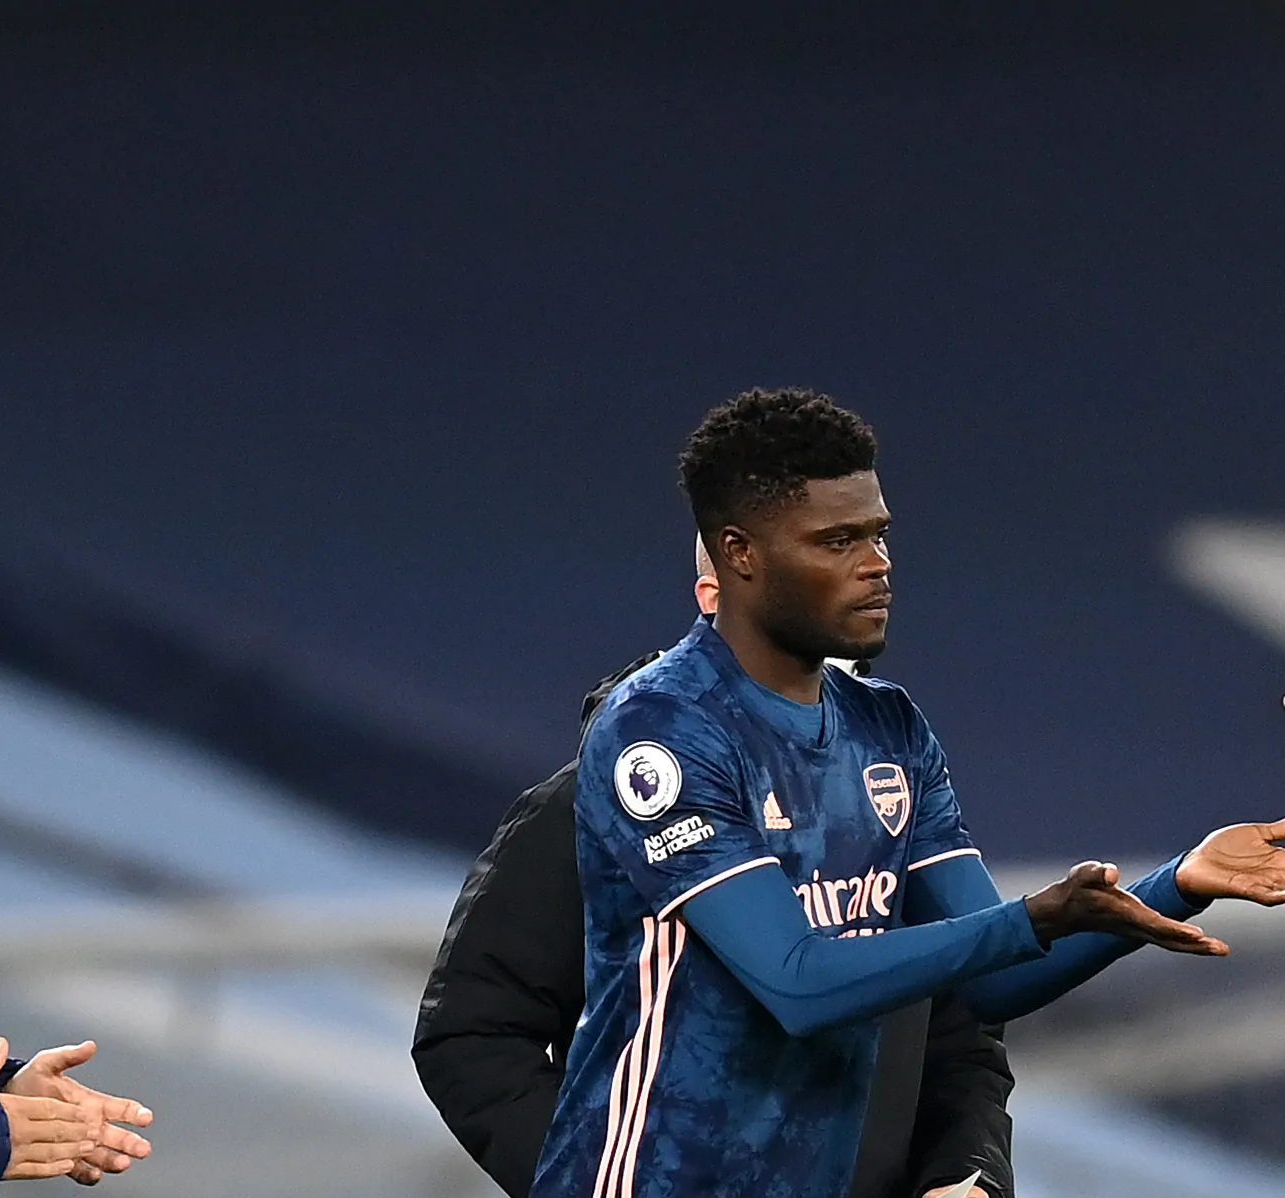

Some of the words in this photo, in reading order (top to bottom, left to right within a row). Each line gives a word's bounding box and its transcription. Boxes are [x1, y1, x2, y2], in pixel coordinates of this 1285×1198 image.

[644, 835, 663, 852] No
[662, 815, 703, 843] room
[668, 823, 715, 856] racism
